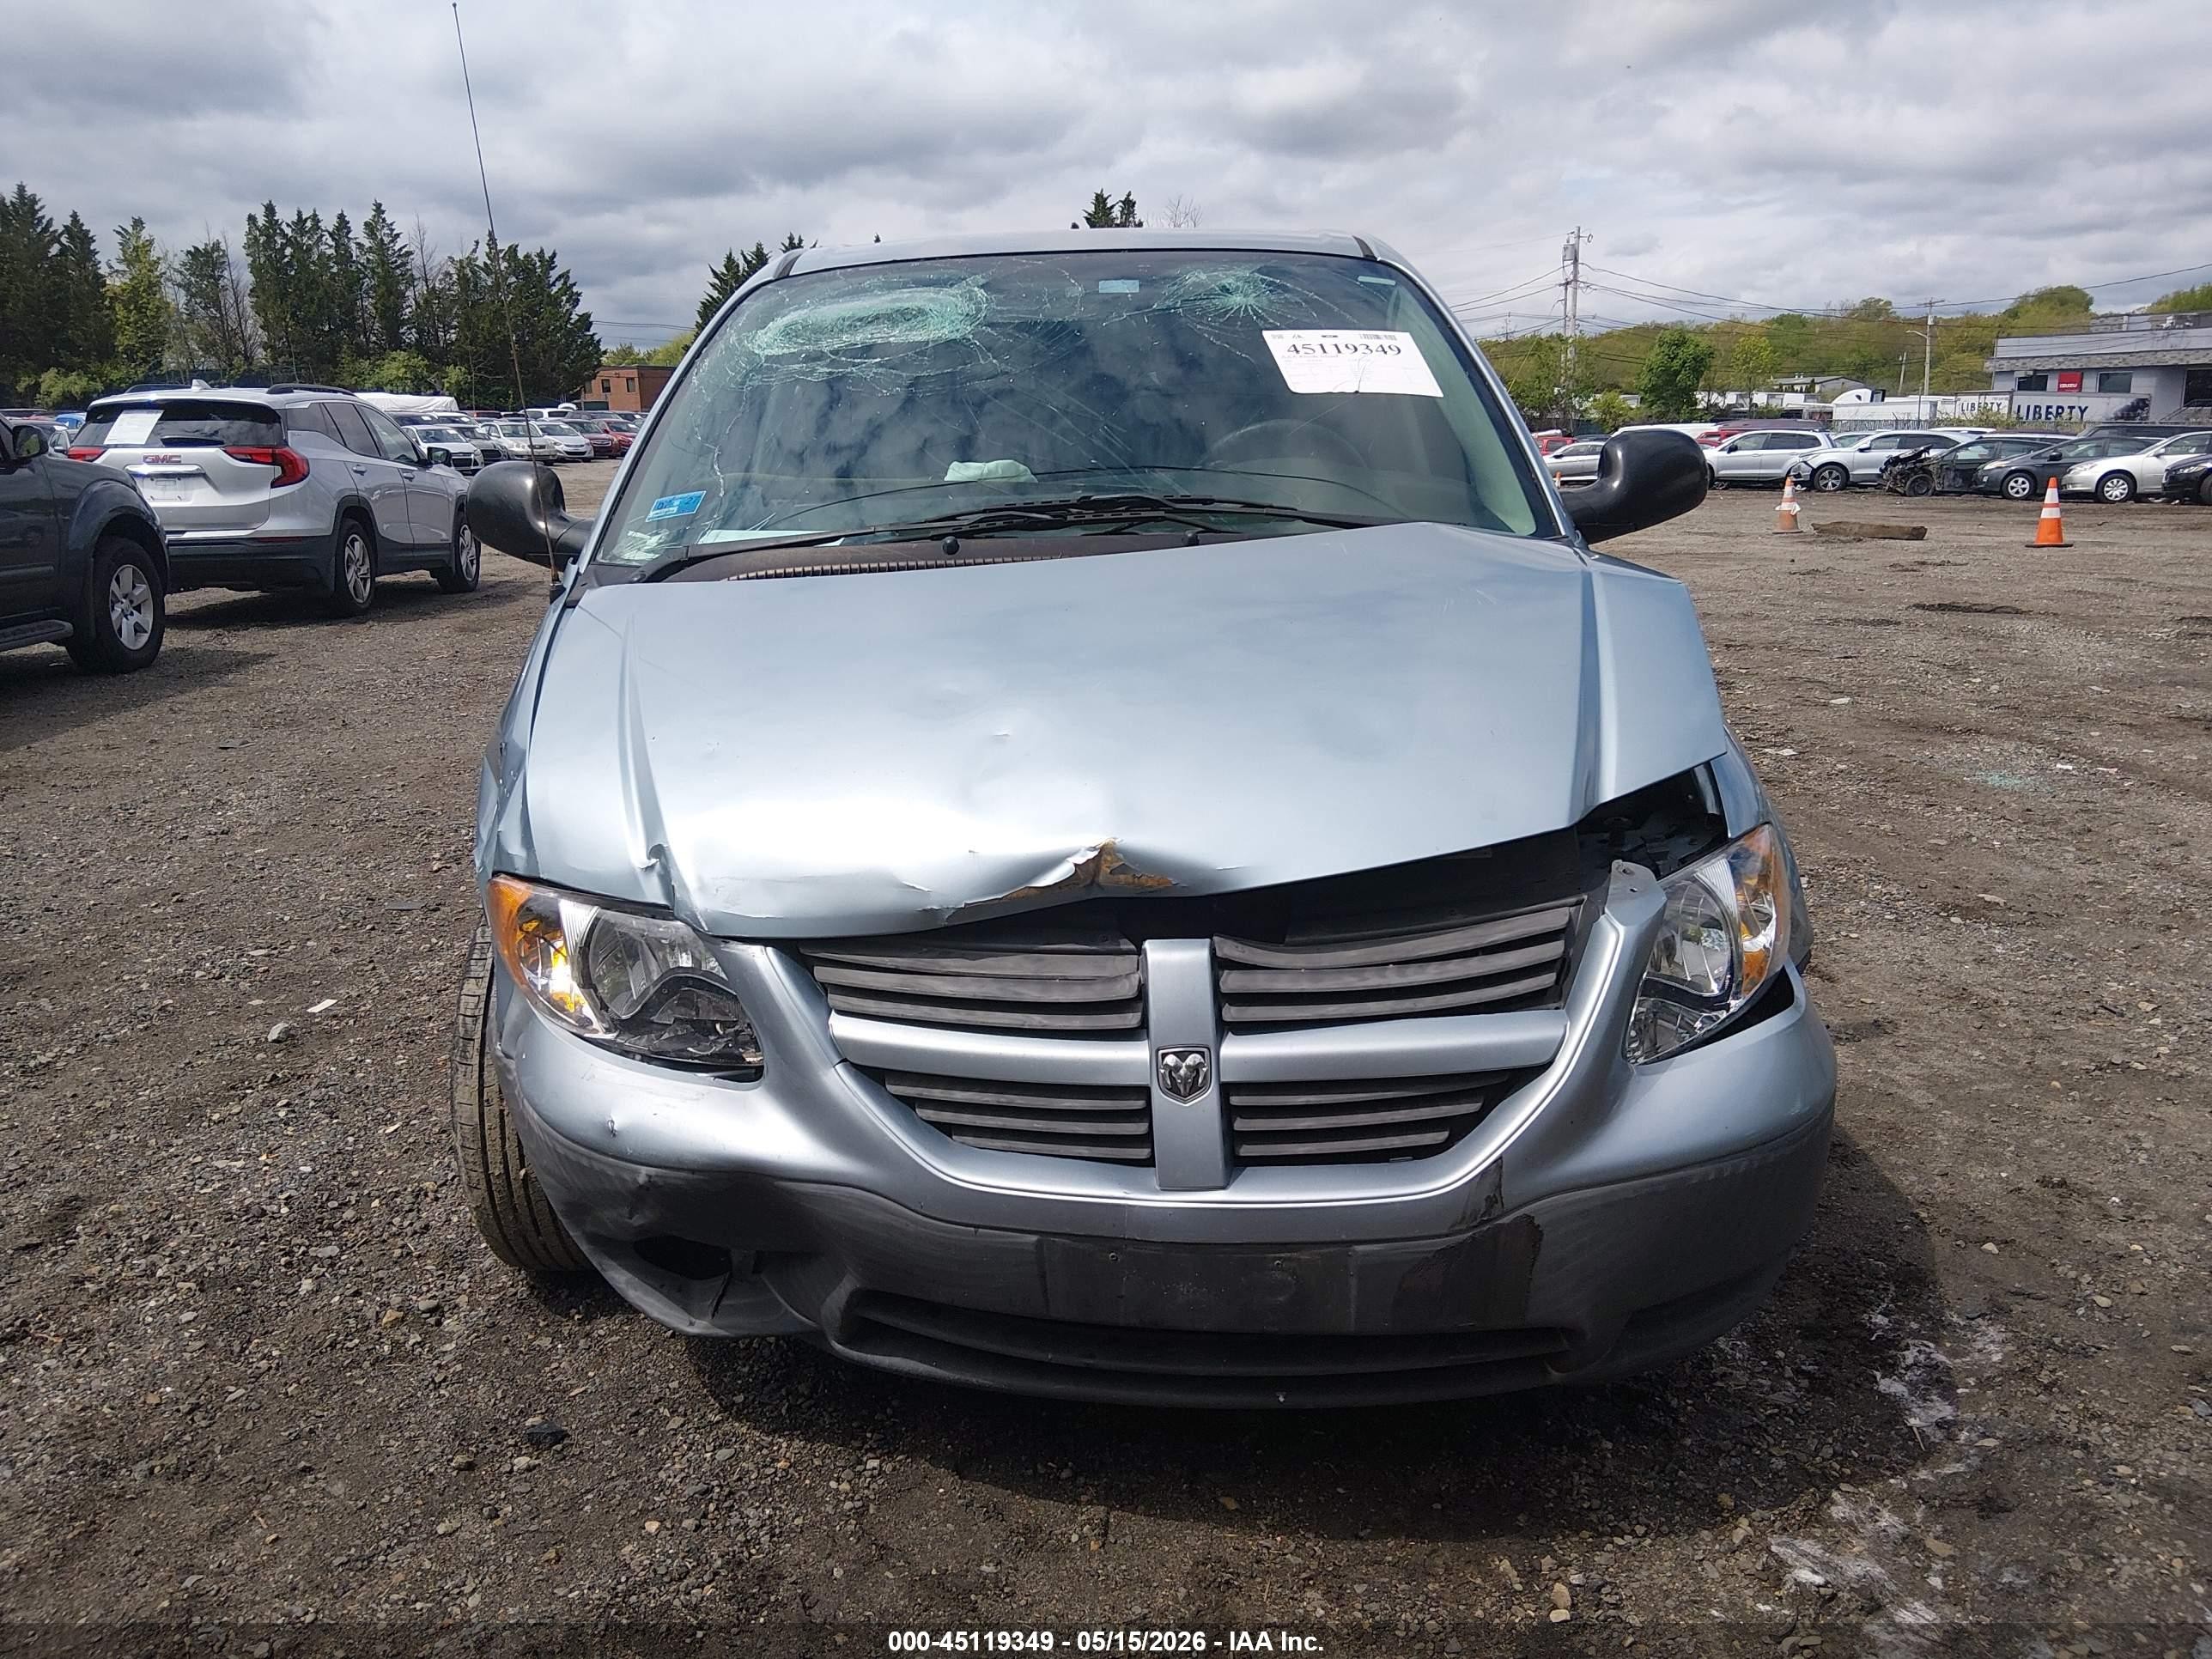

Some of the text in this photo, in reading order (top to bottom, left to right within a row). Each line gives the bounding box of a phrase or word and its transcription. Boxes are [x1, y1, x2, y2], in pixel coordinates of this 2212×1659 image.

[1287, 343, 1401, 356] 45119349
[1961, 402, 2002, 412] LIBERTY
[2016, 404, 2089, 421] LIBERTY
[143, 454, 182, 464] GMC
